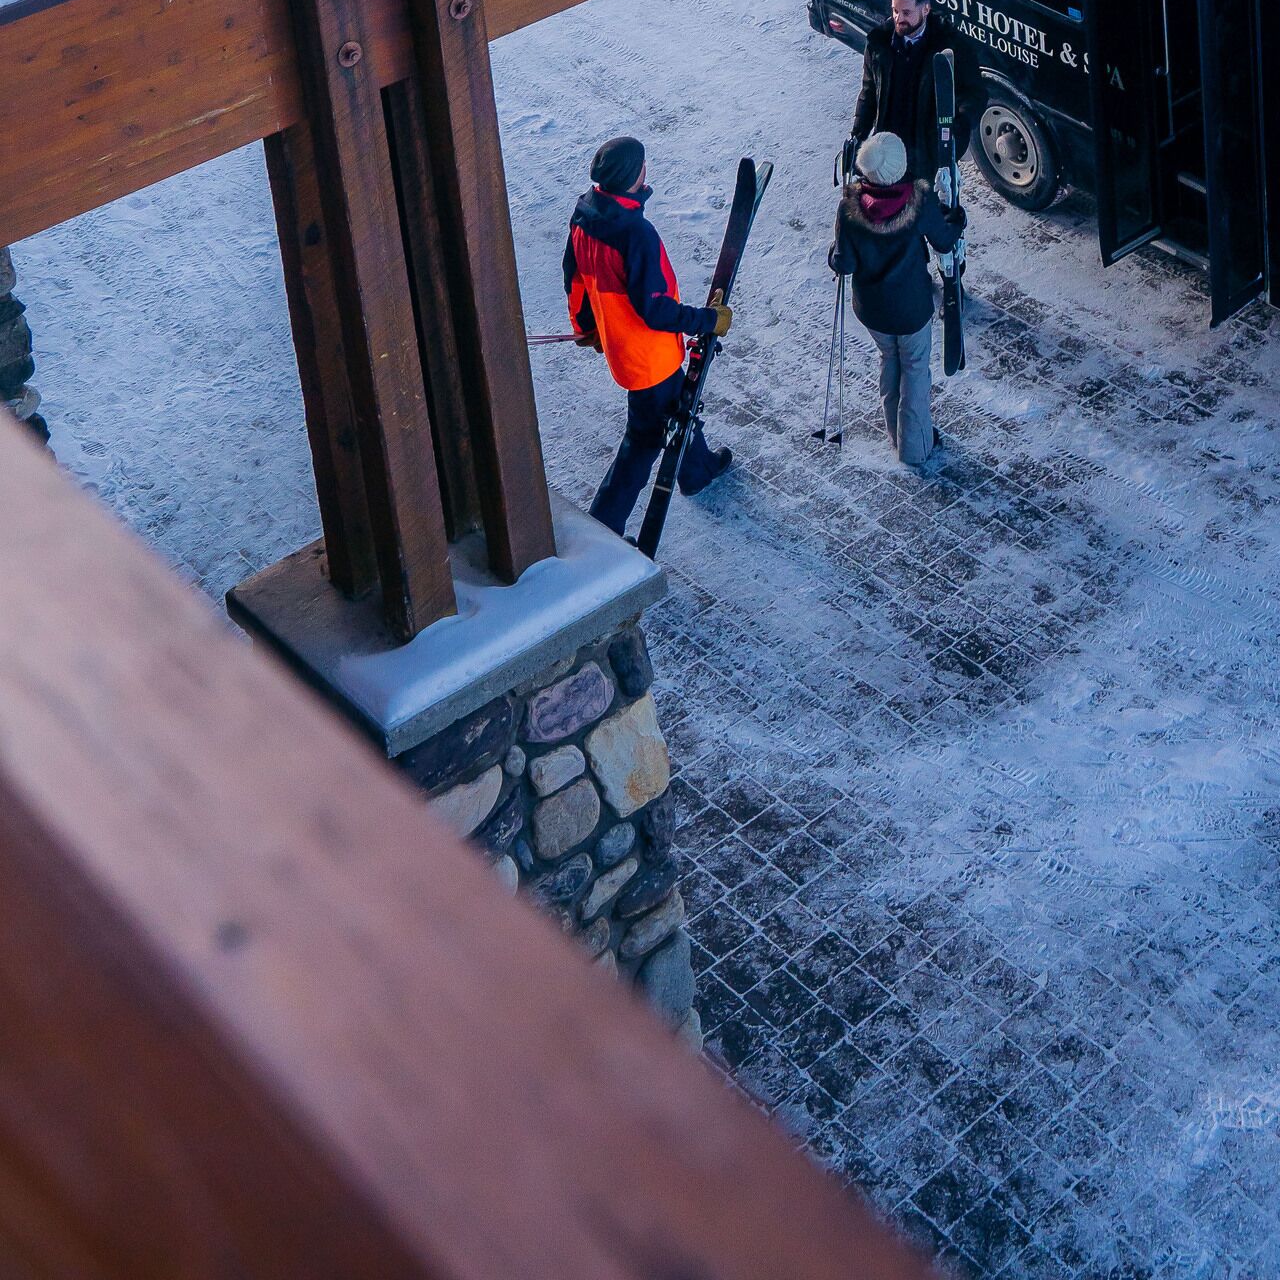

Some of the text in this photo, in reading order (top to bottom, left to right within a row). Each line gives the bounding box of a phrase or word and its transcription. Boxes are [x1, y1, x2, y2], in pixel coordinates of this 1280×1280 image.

[976, 1, 1054, 57] HOTEL
[1060, 42, 1077, 68] &
[989, 33, 1040, 69] LOUISE
